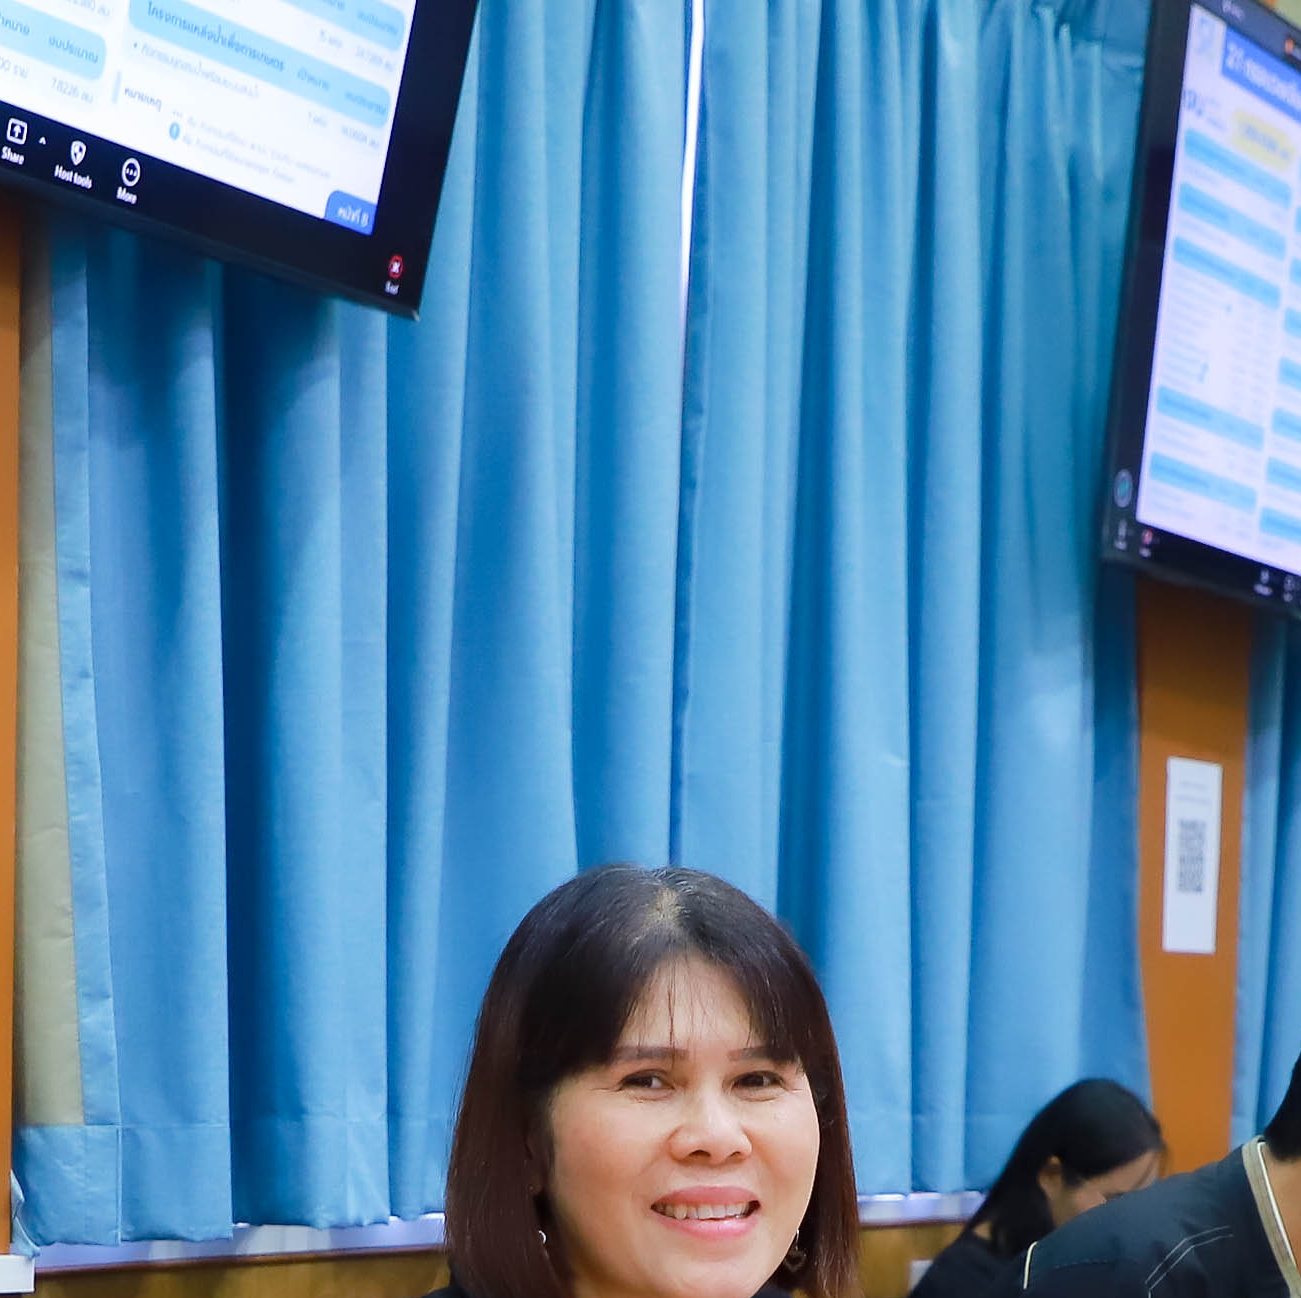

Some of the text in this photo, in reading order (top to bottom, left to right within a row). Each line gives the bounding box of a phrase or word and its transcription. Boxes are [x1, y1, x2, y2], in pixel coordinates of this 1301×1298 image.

[49, 34, 99, 64] งบประมาณ
[123, 86, 163, 113] หมายเหตุ
[1, 146, 25, 166] Share
[54, 164, 93, 190] Host tools
[116, 187, 138, 205] More
